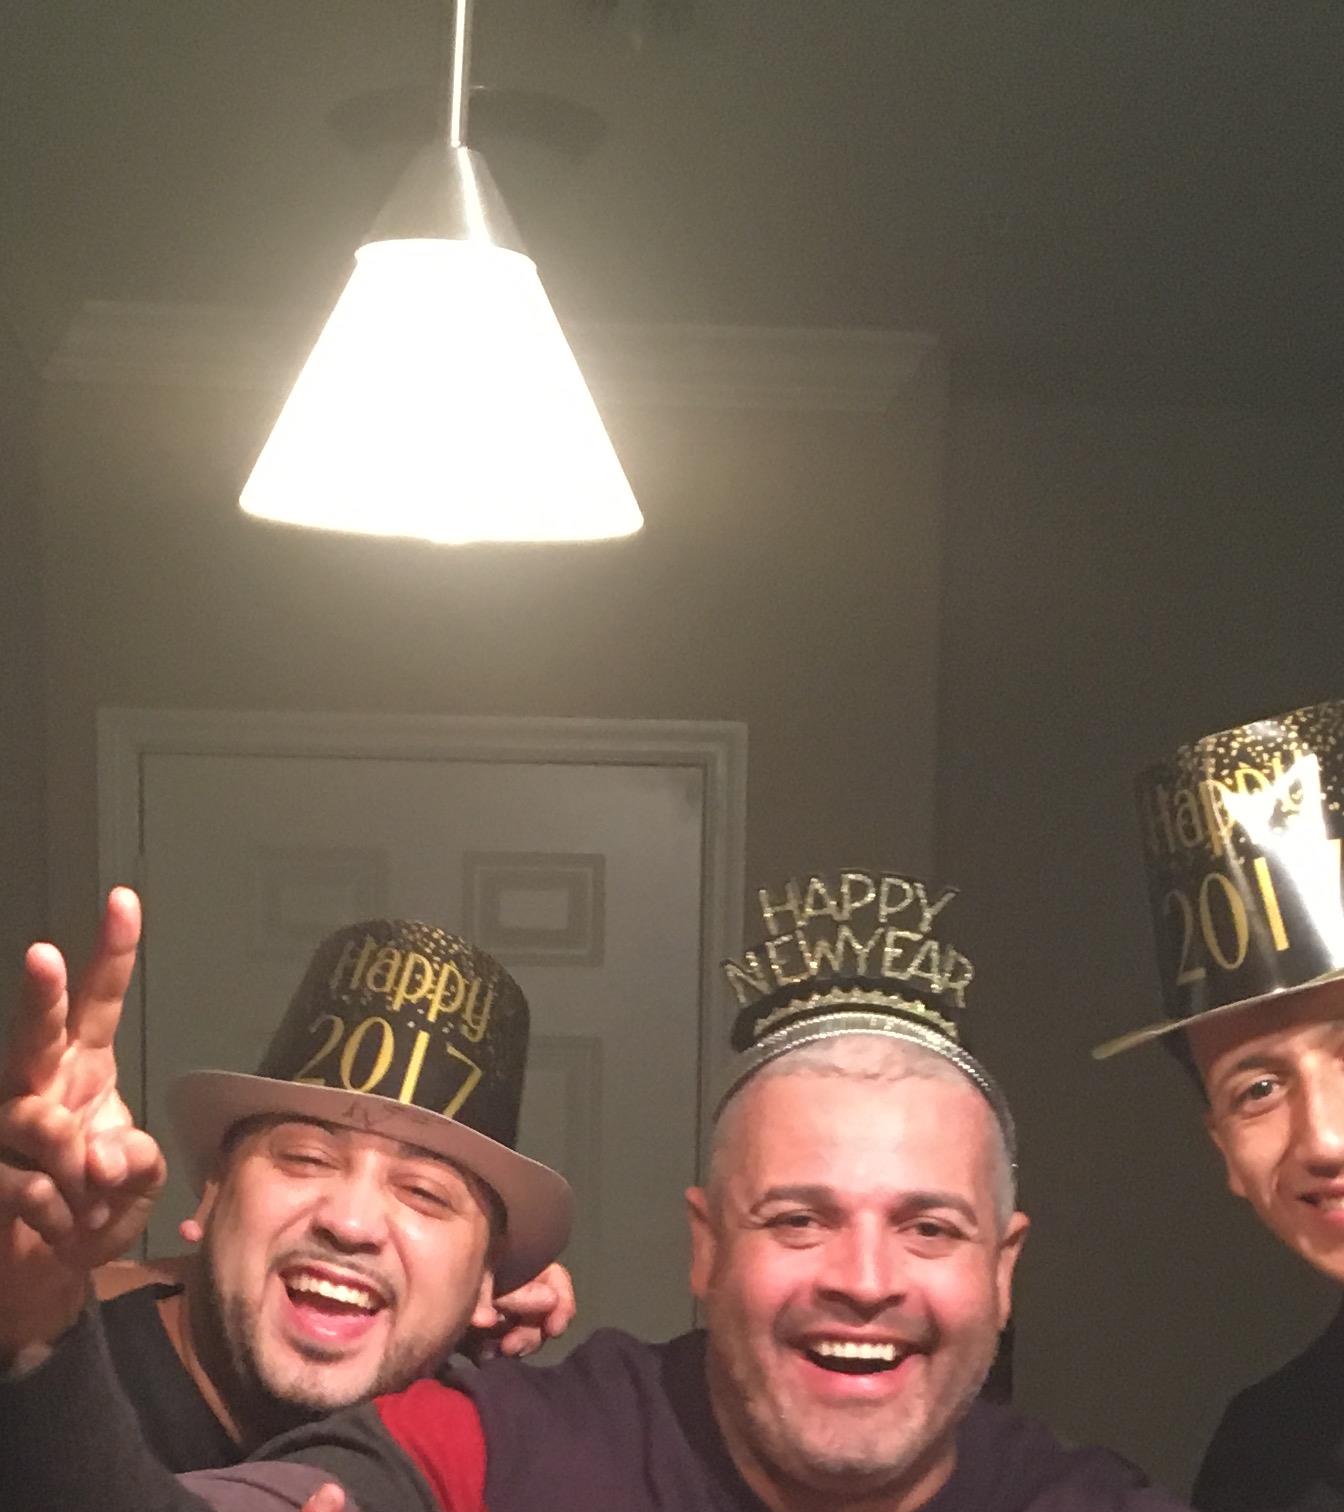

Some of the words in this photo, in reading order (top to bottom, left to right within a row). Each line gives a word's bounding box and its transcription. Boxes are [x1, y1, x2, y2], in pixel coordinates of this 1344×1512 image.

[758, 867, 961, 937] HAPPY
[329, 935, 497, 1043] Happy
[292, 1012, 484, 1118] 2017
